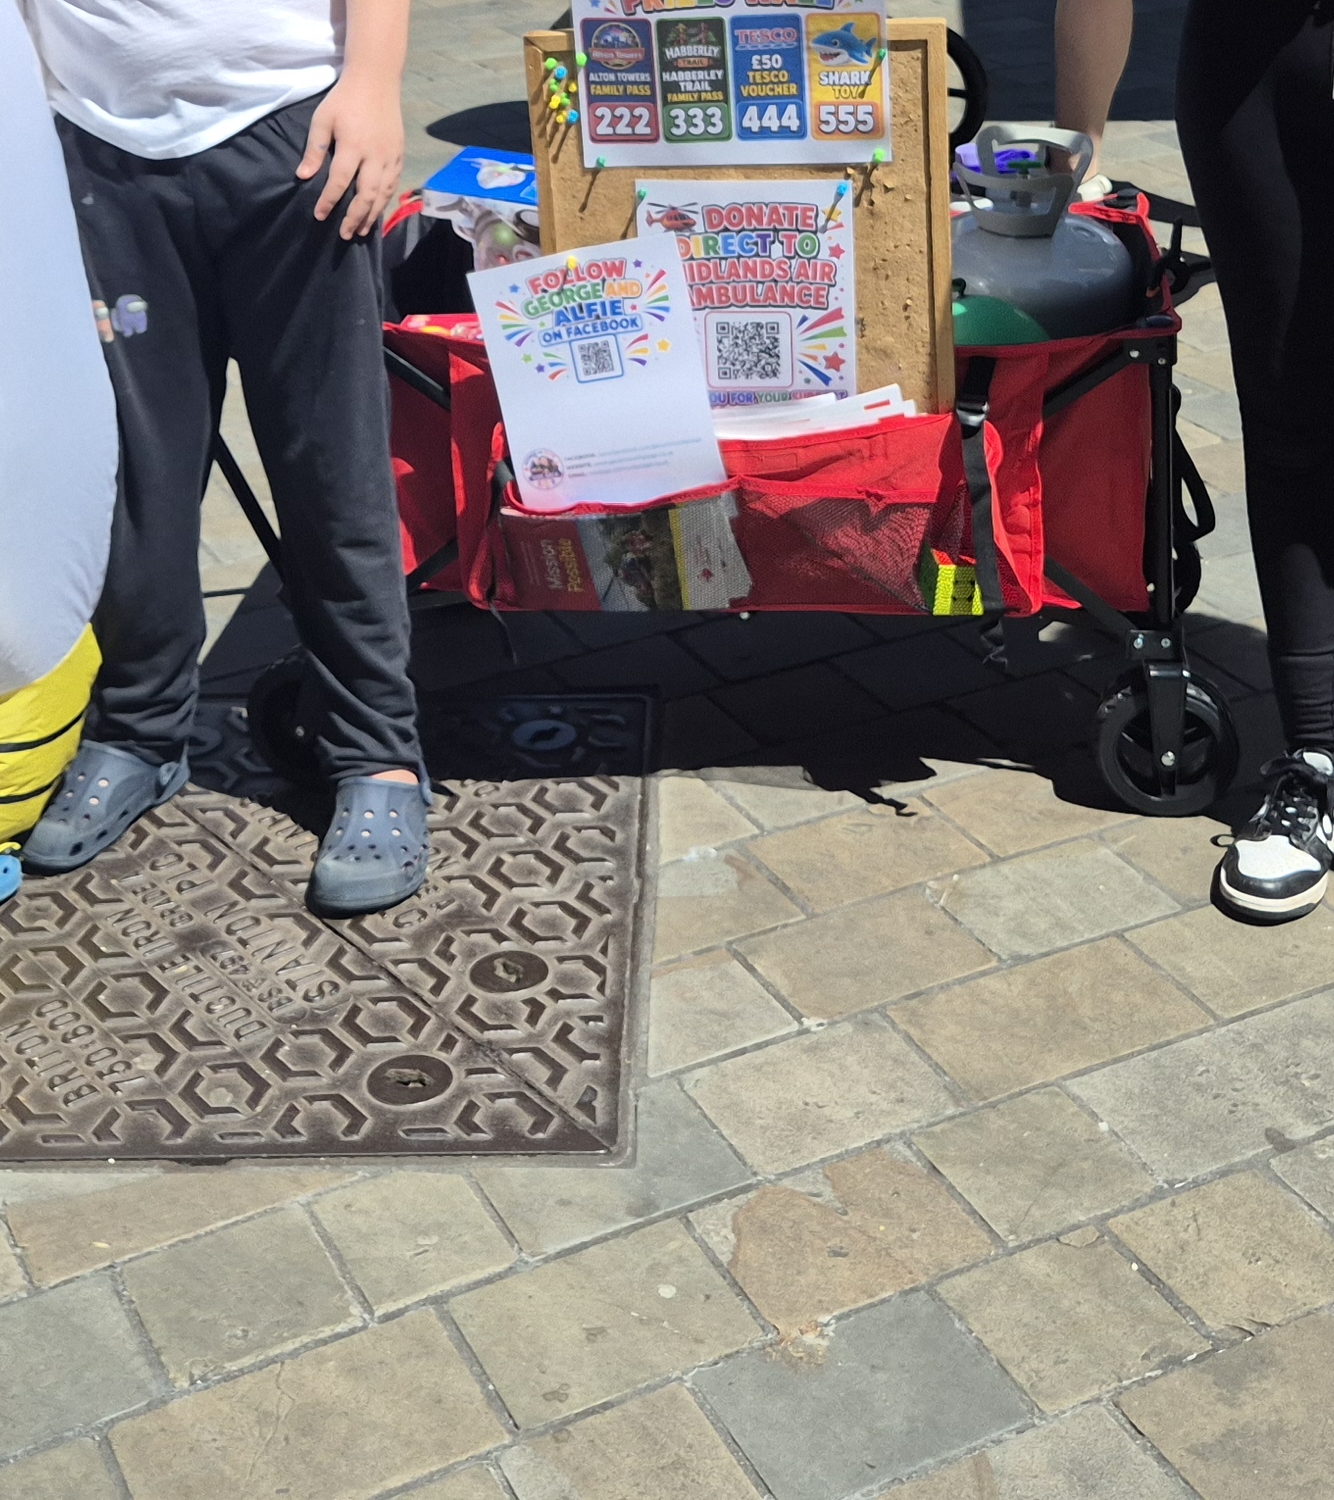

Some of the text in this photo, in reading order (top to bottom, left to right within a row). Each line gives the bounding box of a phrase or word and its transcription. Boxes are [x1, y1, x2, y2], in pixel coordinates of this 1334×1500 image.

[733, 28, 798, 44] TESCO
[664, 46, 720, 59] HABBERLEY
[751, 54, 783, 70] £50
[588, 72, 652, 82] ALTON TOWERS
[662, 68, 723, 82] HABBERLEY
[679, 80, 712, 91] TRAIL
[747, 70, 789, 83] TESCO
[818, 70, 873, 86] SHARK
[590, 84, 652, 97] FAMILY PASS
[667, 91, 724, 103] FAMILY PASS
[740, 83, 798, 97] VOUCHER
[832, 85, 860, 98] TOY
[594, 105, 652, 136] 222
[669, 105, 724, 136] 333
[741, 103, 801, 133] 444
[818, 104, 875, 134] 555
[702, 202, 818, 231] DONATE
[676, 230, 820, 259] DIRECT TO
[526, 257, 628, 296] FOLLOW
[683, 258, 837, 286] IDLANDS AIR
[521, 279, 643, 319] GEORGE AND
[553, 299, 624, 327] ALFIE
[542, 317, 640, 344] ON FACEBOOK
[709, 390, 728, 406] OU
[729, 391, 755, 406] FOR
[756, 390, 791, 403] YOUR
[131, 881, 194, 929] GRADE
[149, 852, 341, 1004] STANTON PLC
[106, 907, 269, 1042] DUCTILE IRON
[34, 999, 95, 1045] 600
[85, 1046, 146, 1095] 750
